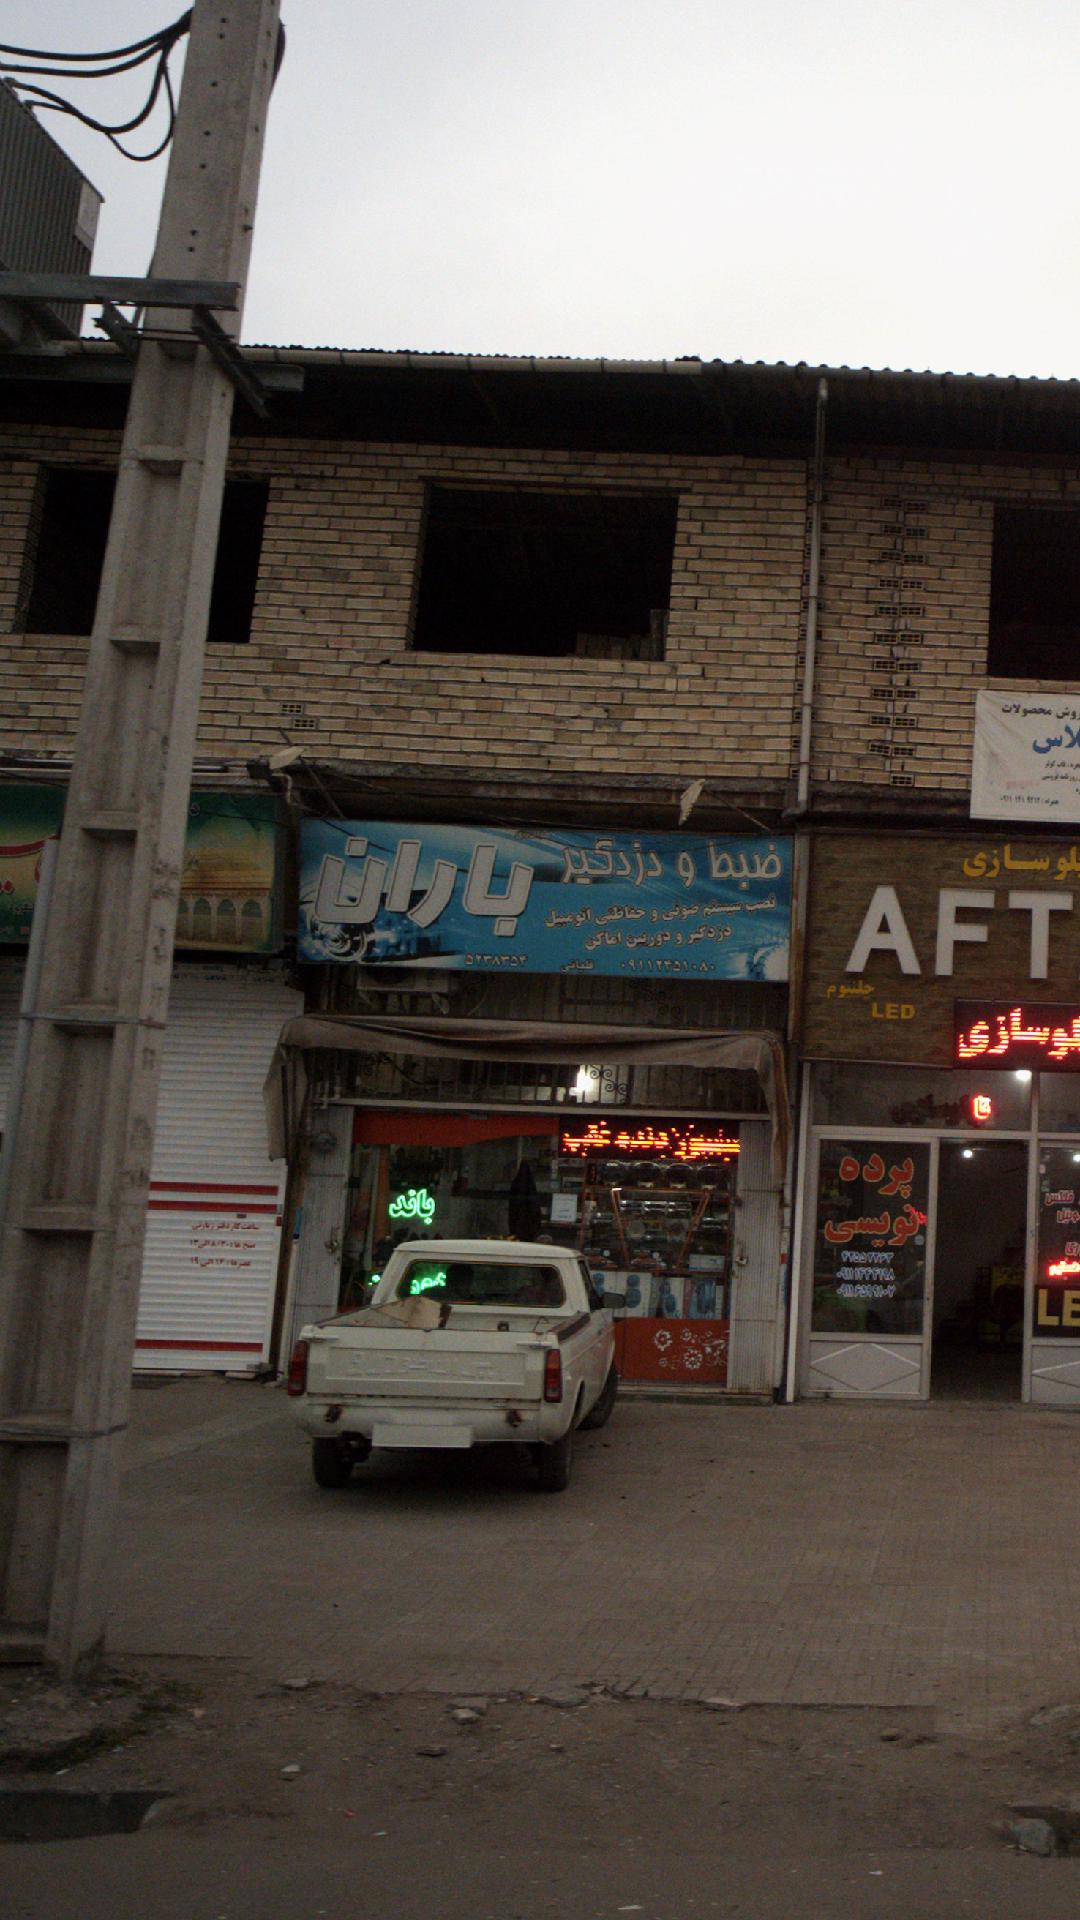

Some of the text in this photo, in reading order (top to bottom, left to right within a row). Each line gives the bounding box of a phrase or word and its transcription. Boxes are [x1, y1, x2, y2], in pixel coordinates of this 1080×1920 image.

[1001, 703, 1053, 718] محصولات
[560, 837, 783, 890] ضبط و دزدگیر
[962, 843, 1050, 879] سازی
[315, 837, 534, 937] باران
[545, 896, 776, 928] نصب سیستم صوتی و حفاظتی اتومبیل
[844, 884, 1080, 980] AFT
[585, 924, 732, 950] دزدگیر و دوربین اماکن
[871, 1001, 916, 1020] LED
[839, 1153, 914, 1199] پرده
[824, 1204, 919, 1248] نویسی
